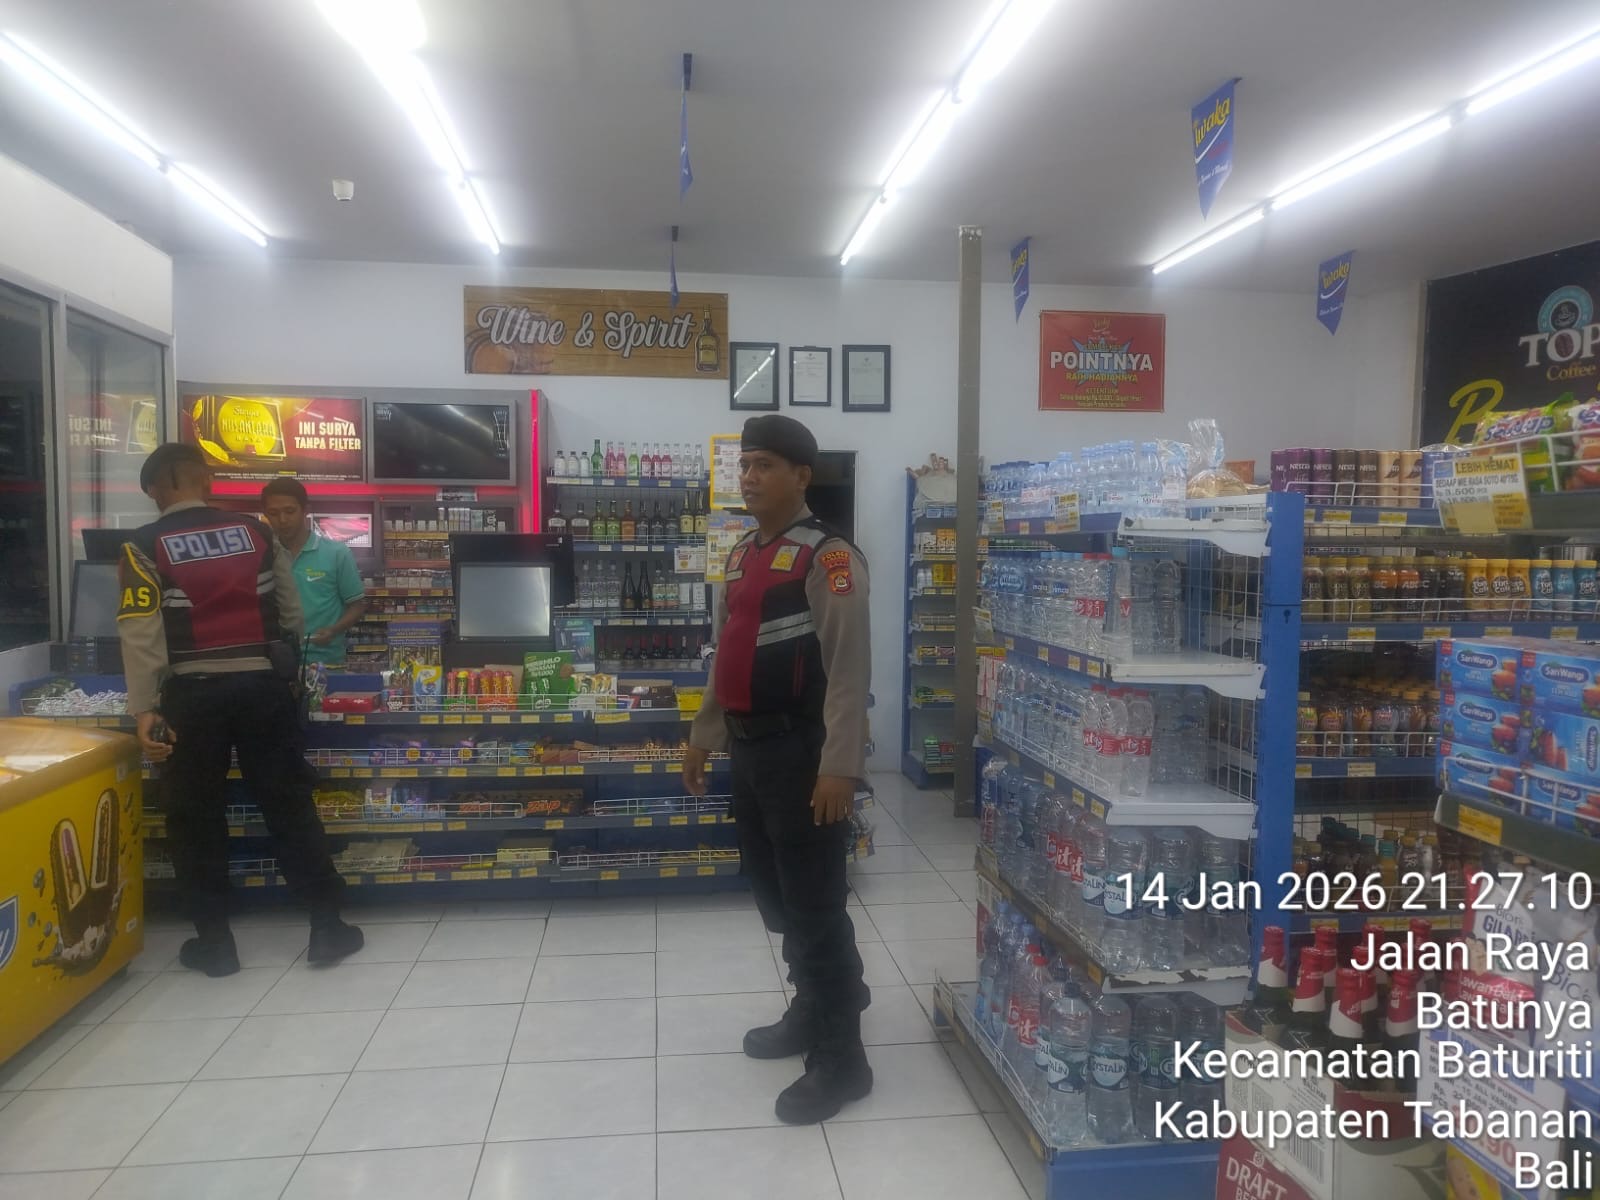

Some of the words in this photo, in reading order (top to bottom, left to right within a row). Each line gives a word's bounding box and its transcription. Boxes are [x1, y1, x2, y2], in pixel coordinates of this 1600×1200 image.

[475, 303, 566, 347] Wine
[573, 311, 596, 349] &
[603, 310, 696, 359] Spirit
[1518, 323, 1600, 367] TOP
[1050, 351, 1154, 372] POINTNYA
[1546, 364, 1597, 382] Coffee
[298, 421, 316, 436] INI
[319, 421, 357, 437] SURYA
[294, 437, 326, 450] TANPA
[328, 438, 362, 451] FILTER
[1455, 462, 1481, 474] LEBIH
[1484, 458, 1516, 471] HEMAT
[165, 528, 252, 561] POLISI
[1460, 653, 1494, 668] SariWangi
[1544, 665, 1585, 680] SariWangi
[1462, 705, 1493, 720] SariWangi
[1225, 1155, 1288, 1200] DRAFT
